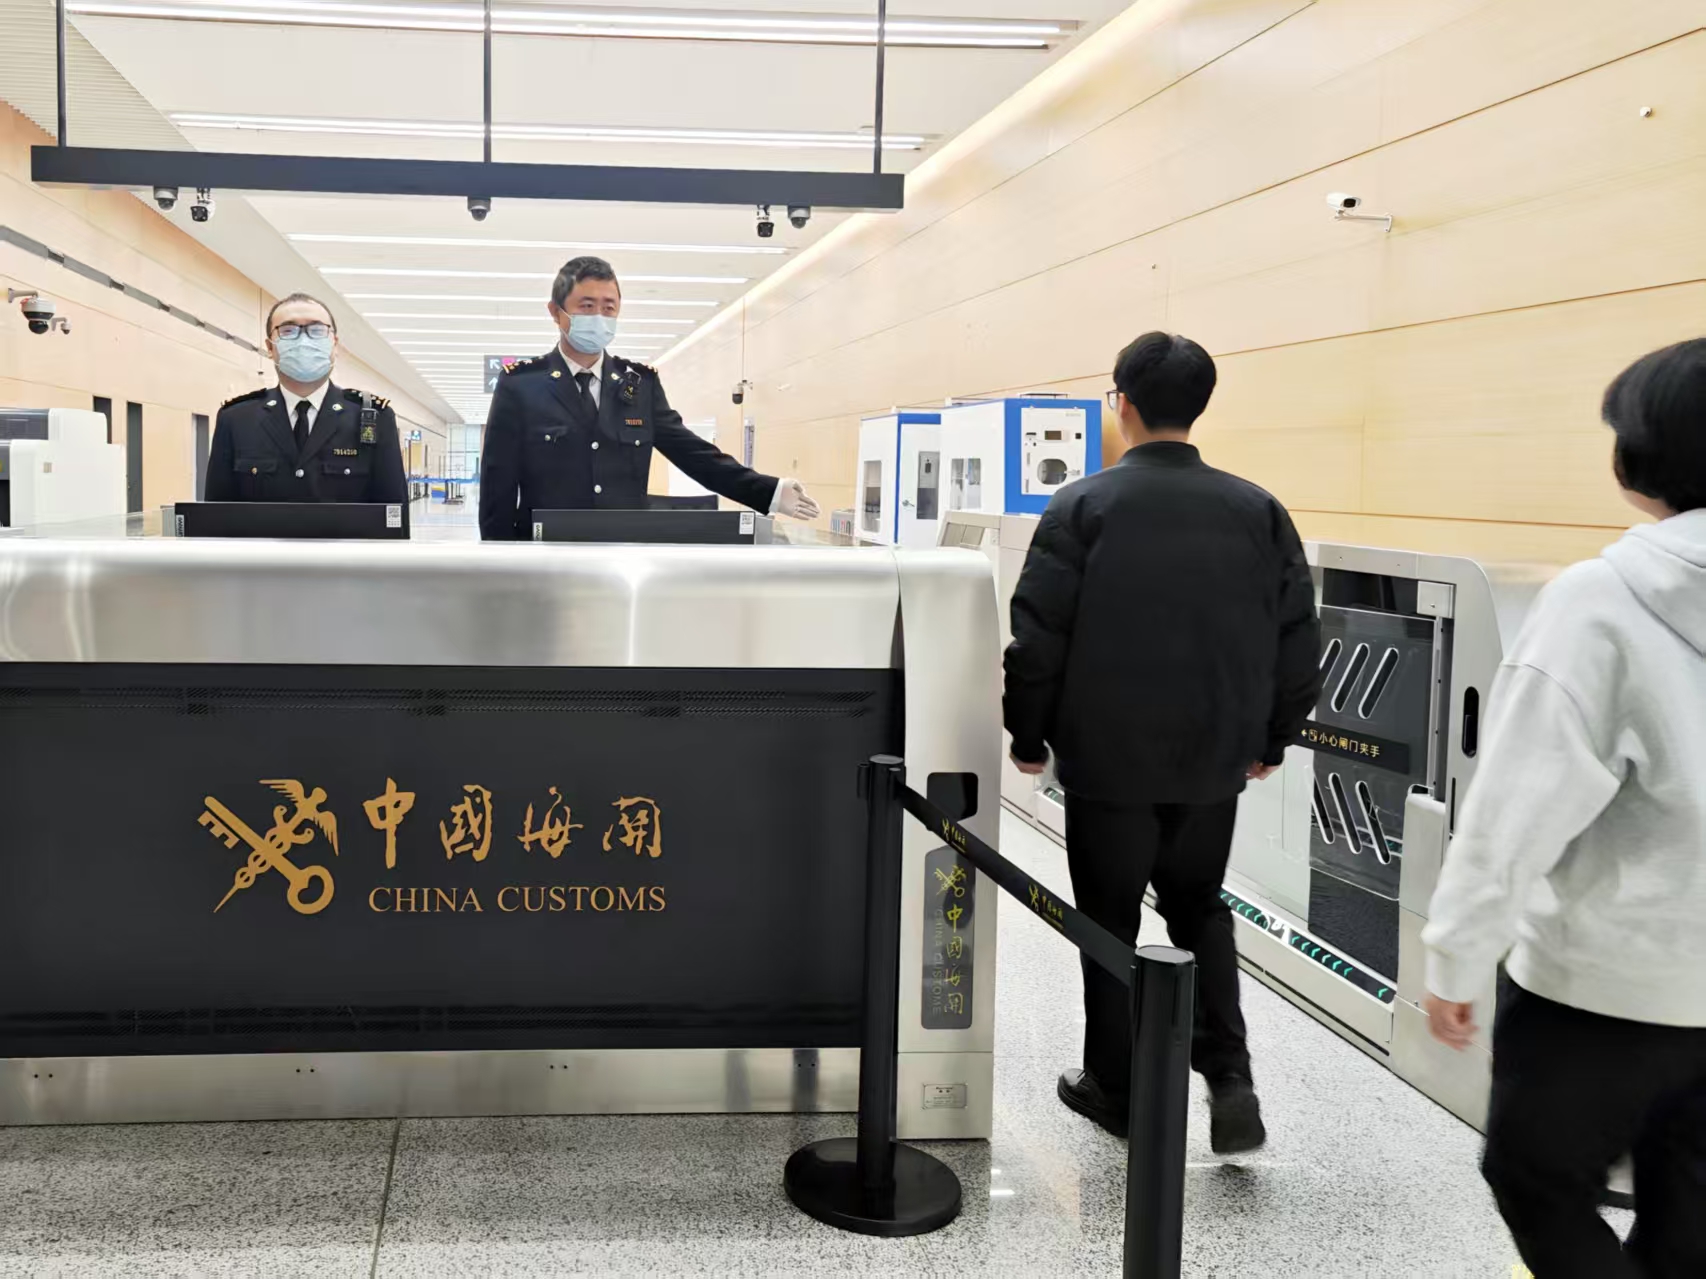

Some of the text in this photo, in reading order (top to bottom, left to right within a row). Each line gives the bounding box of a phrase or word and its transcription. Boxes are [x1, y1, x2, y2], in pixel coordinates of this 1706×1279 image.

[1319, 732, 1380, 757] 小心闸门夹手
[368, 886, 667, 914] CHINA CUSTOMS
